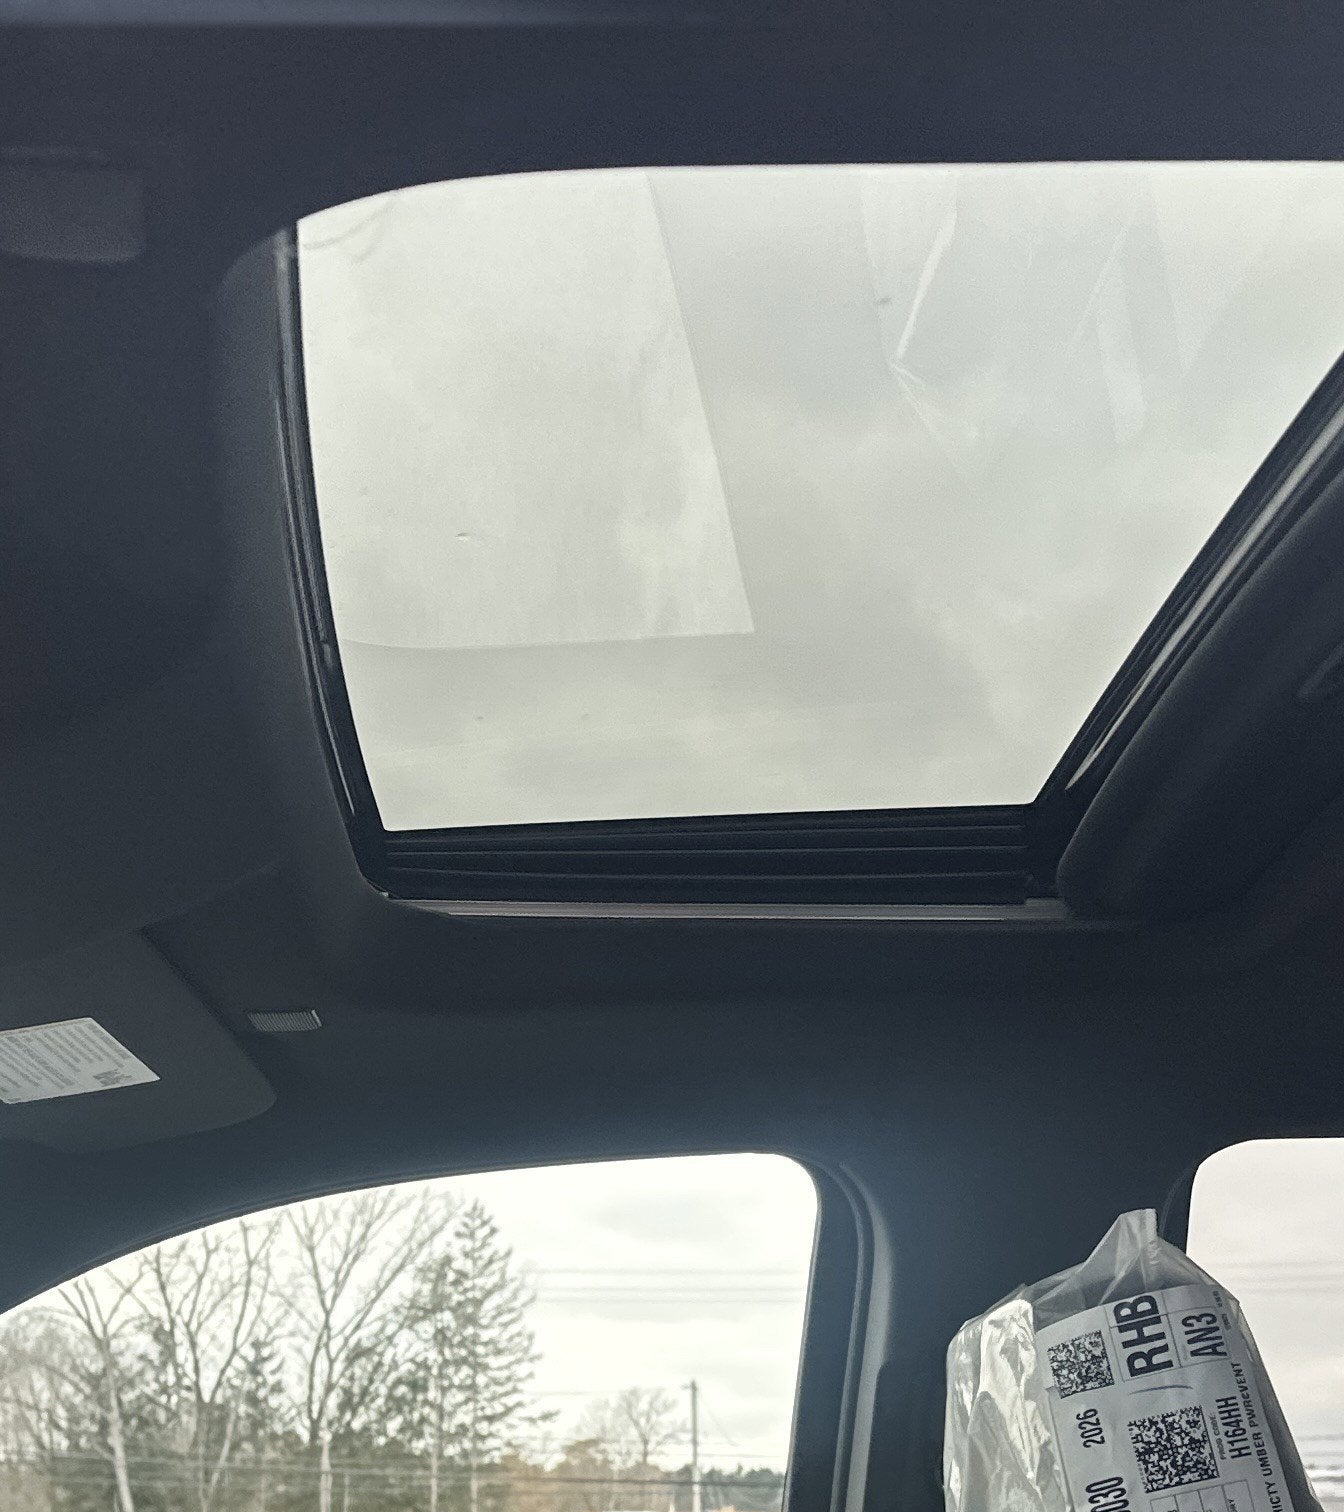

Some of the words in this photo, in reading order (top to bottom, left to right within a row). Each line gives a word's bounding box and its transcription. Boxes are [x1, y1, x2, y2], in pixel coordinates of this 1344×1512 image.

[1113, 1295, 1174, 1377] RHB
[1181, 1312, 1228, 1357] AN3
[1076, 1408, 1106, 1449] 2026
[1215, 1395, 1253, 1459] H164HH
[1251, 1431, 1273, 1477] UMBER
